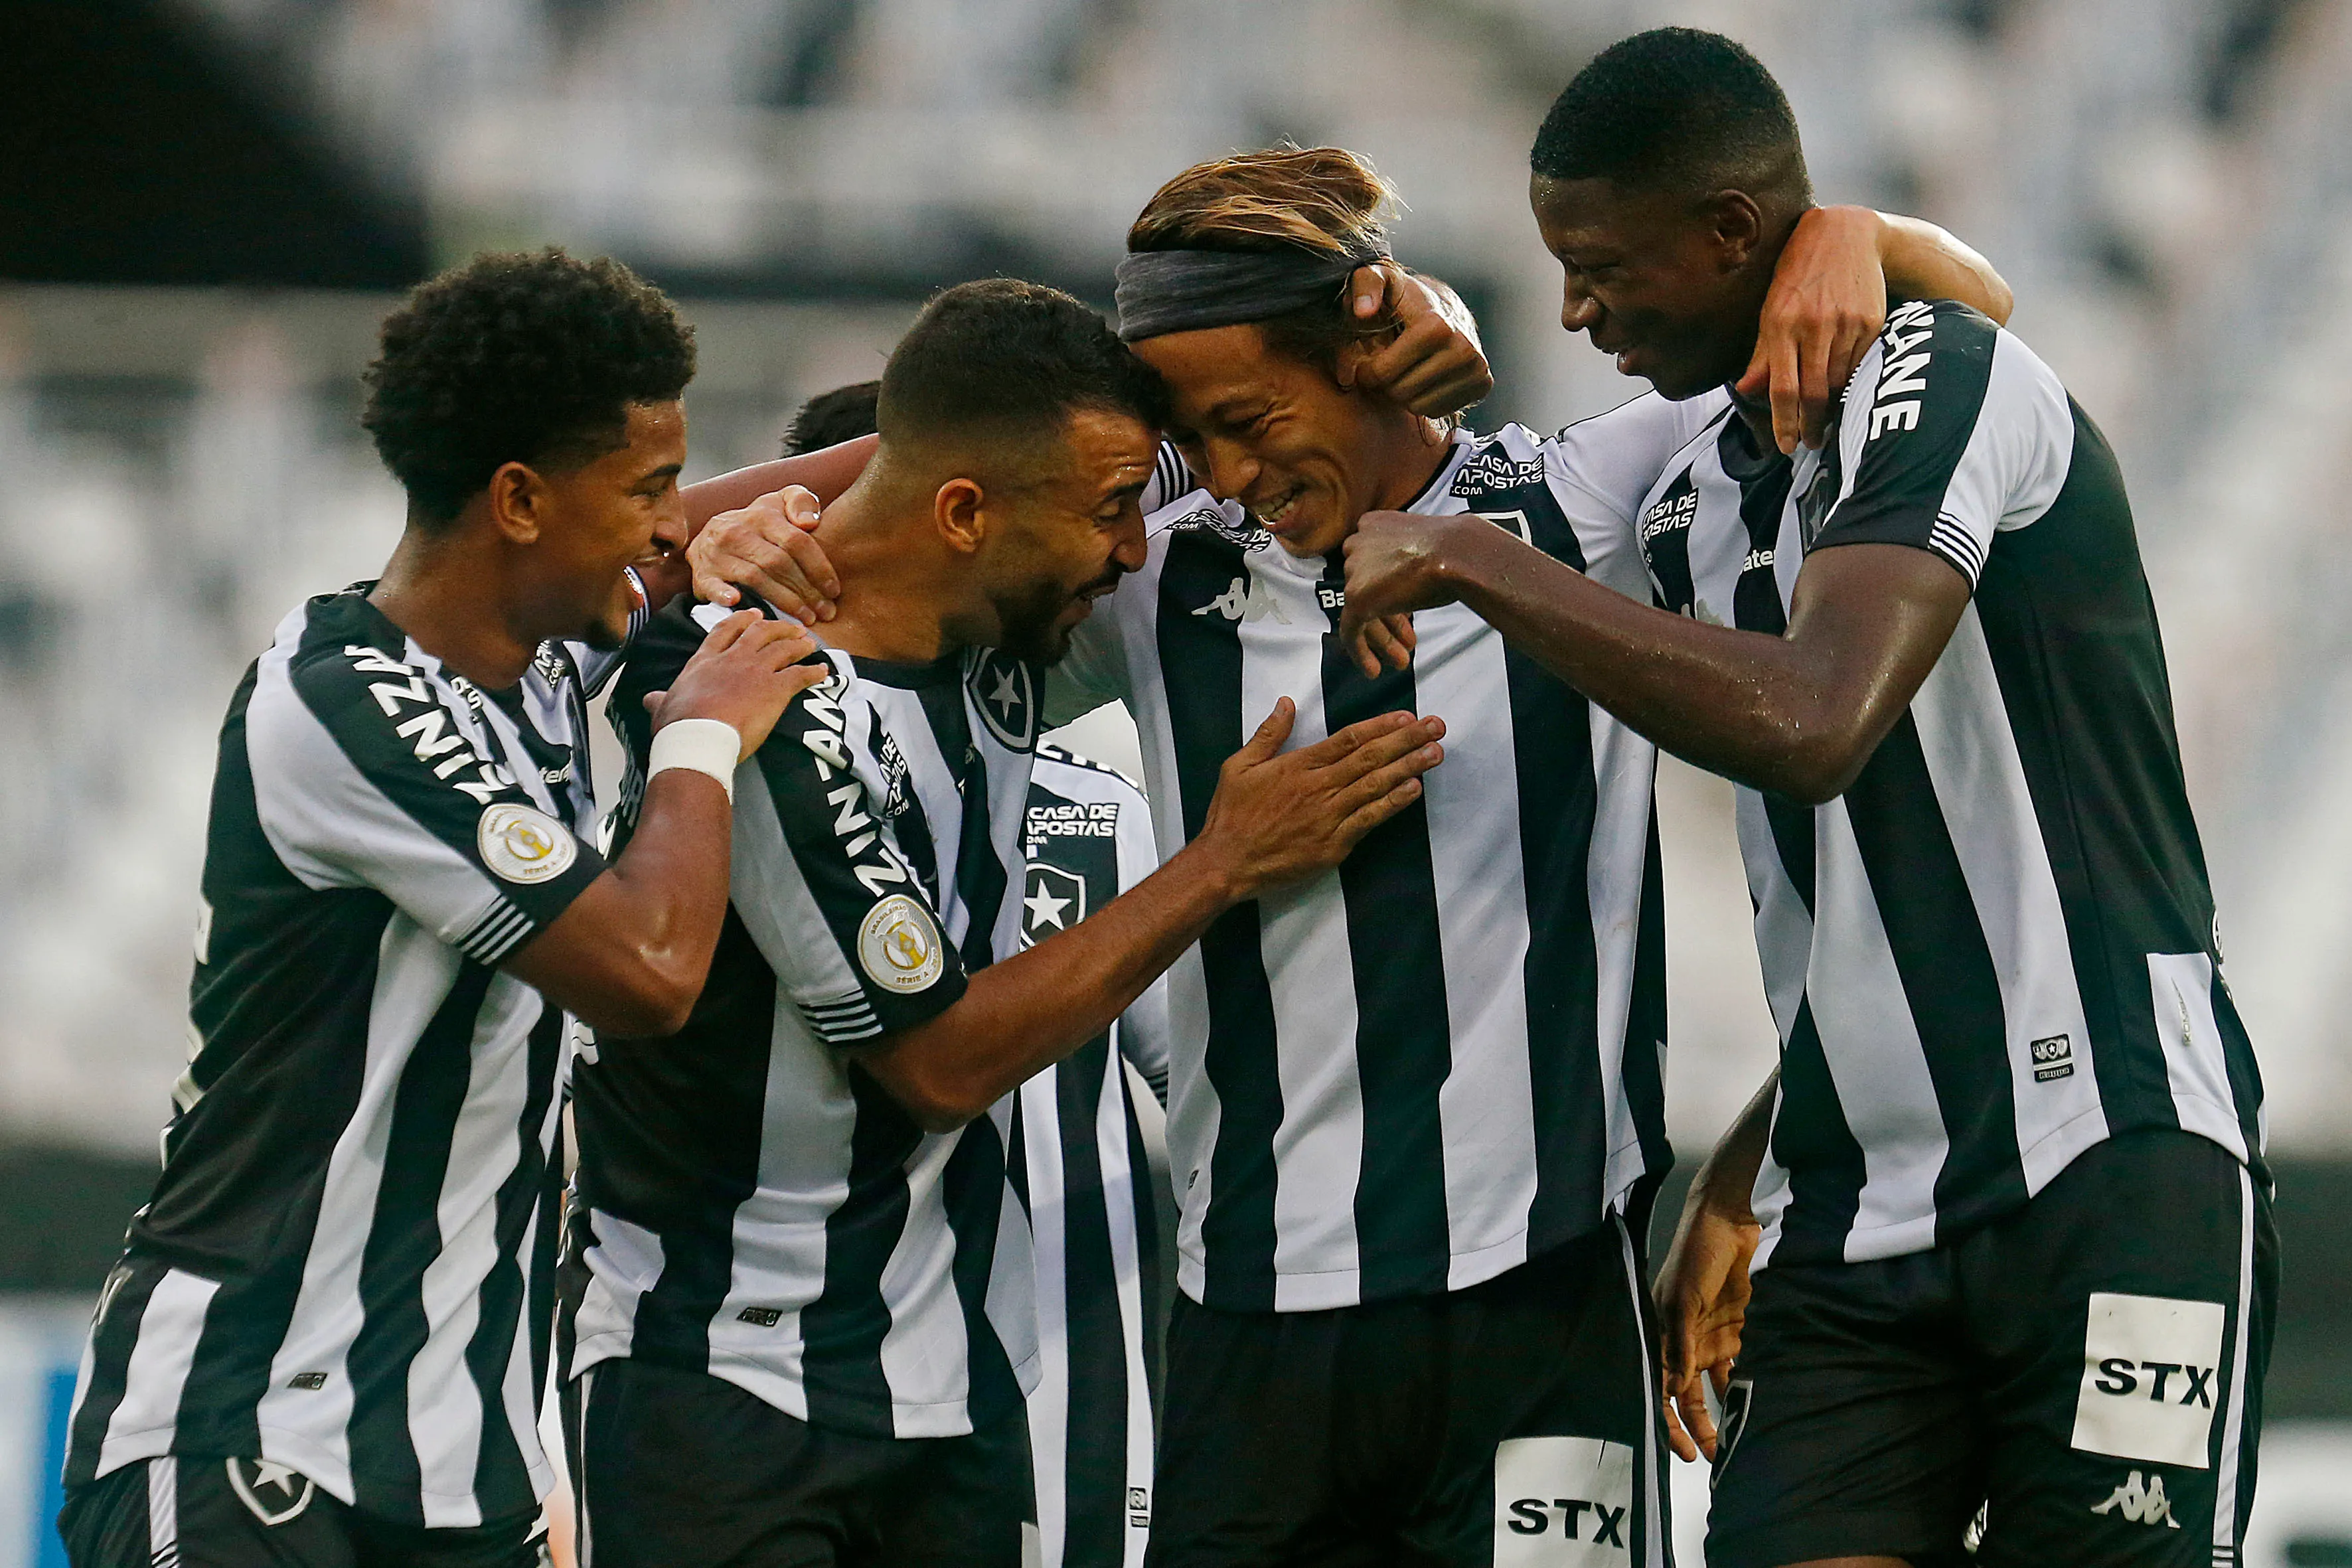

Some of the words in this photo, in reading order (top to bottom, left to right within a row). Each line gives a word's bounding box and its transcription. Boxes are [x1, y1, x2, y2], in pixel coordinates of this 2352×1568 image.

[1519, 455, 1543, 475] DE
[1456, 469, 1543, 489] APOSTAS
[1452, 485, 1482, 495] .COM
[1675, 491, 1697, 512] DE
[1028, 805, 1085, 821] CASA
[1088, 804, 1118, 820] DE
[2095, 1358, 2213, 1409] STX
[1508, 1498, 1626, 1549] STX
